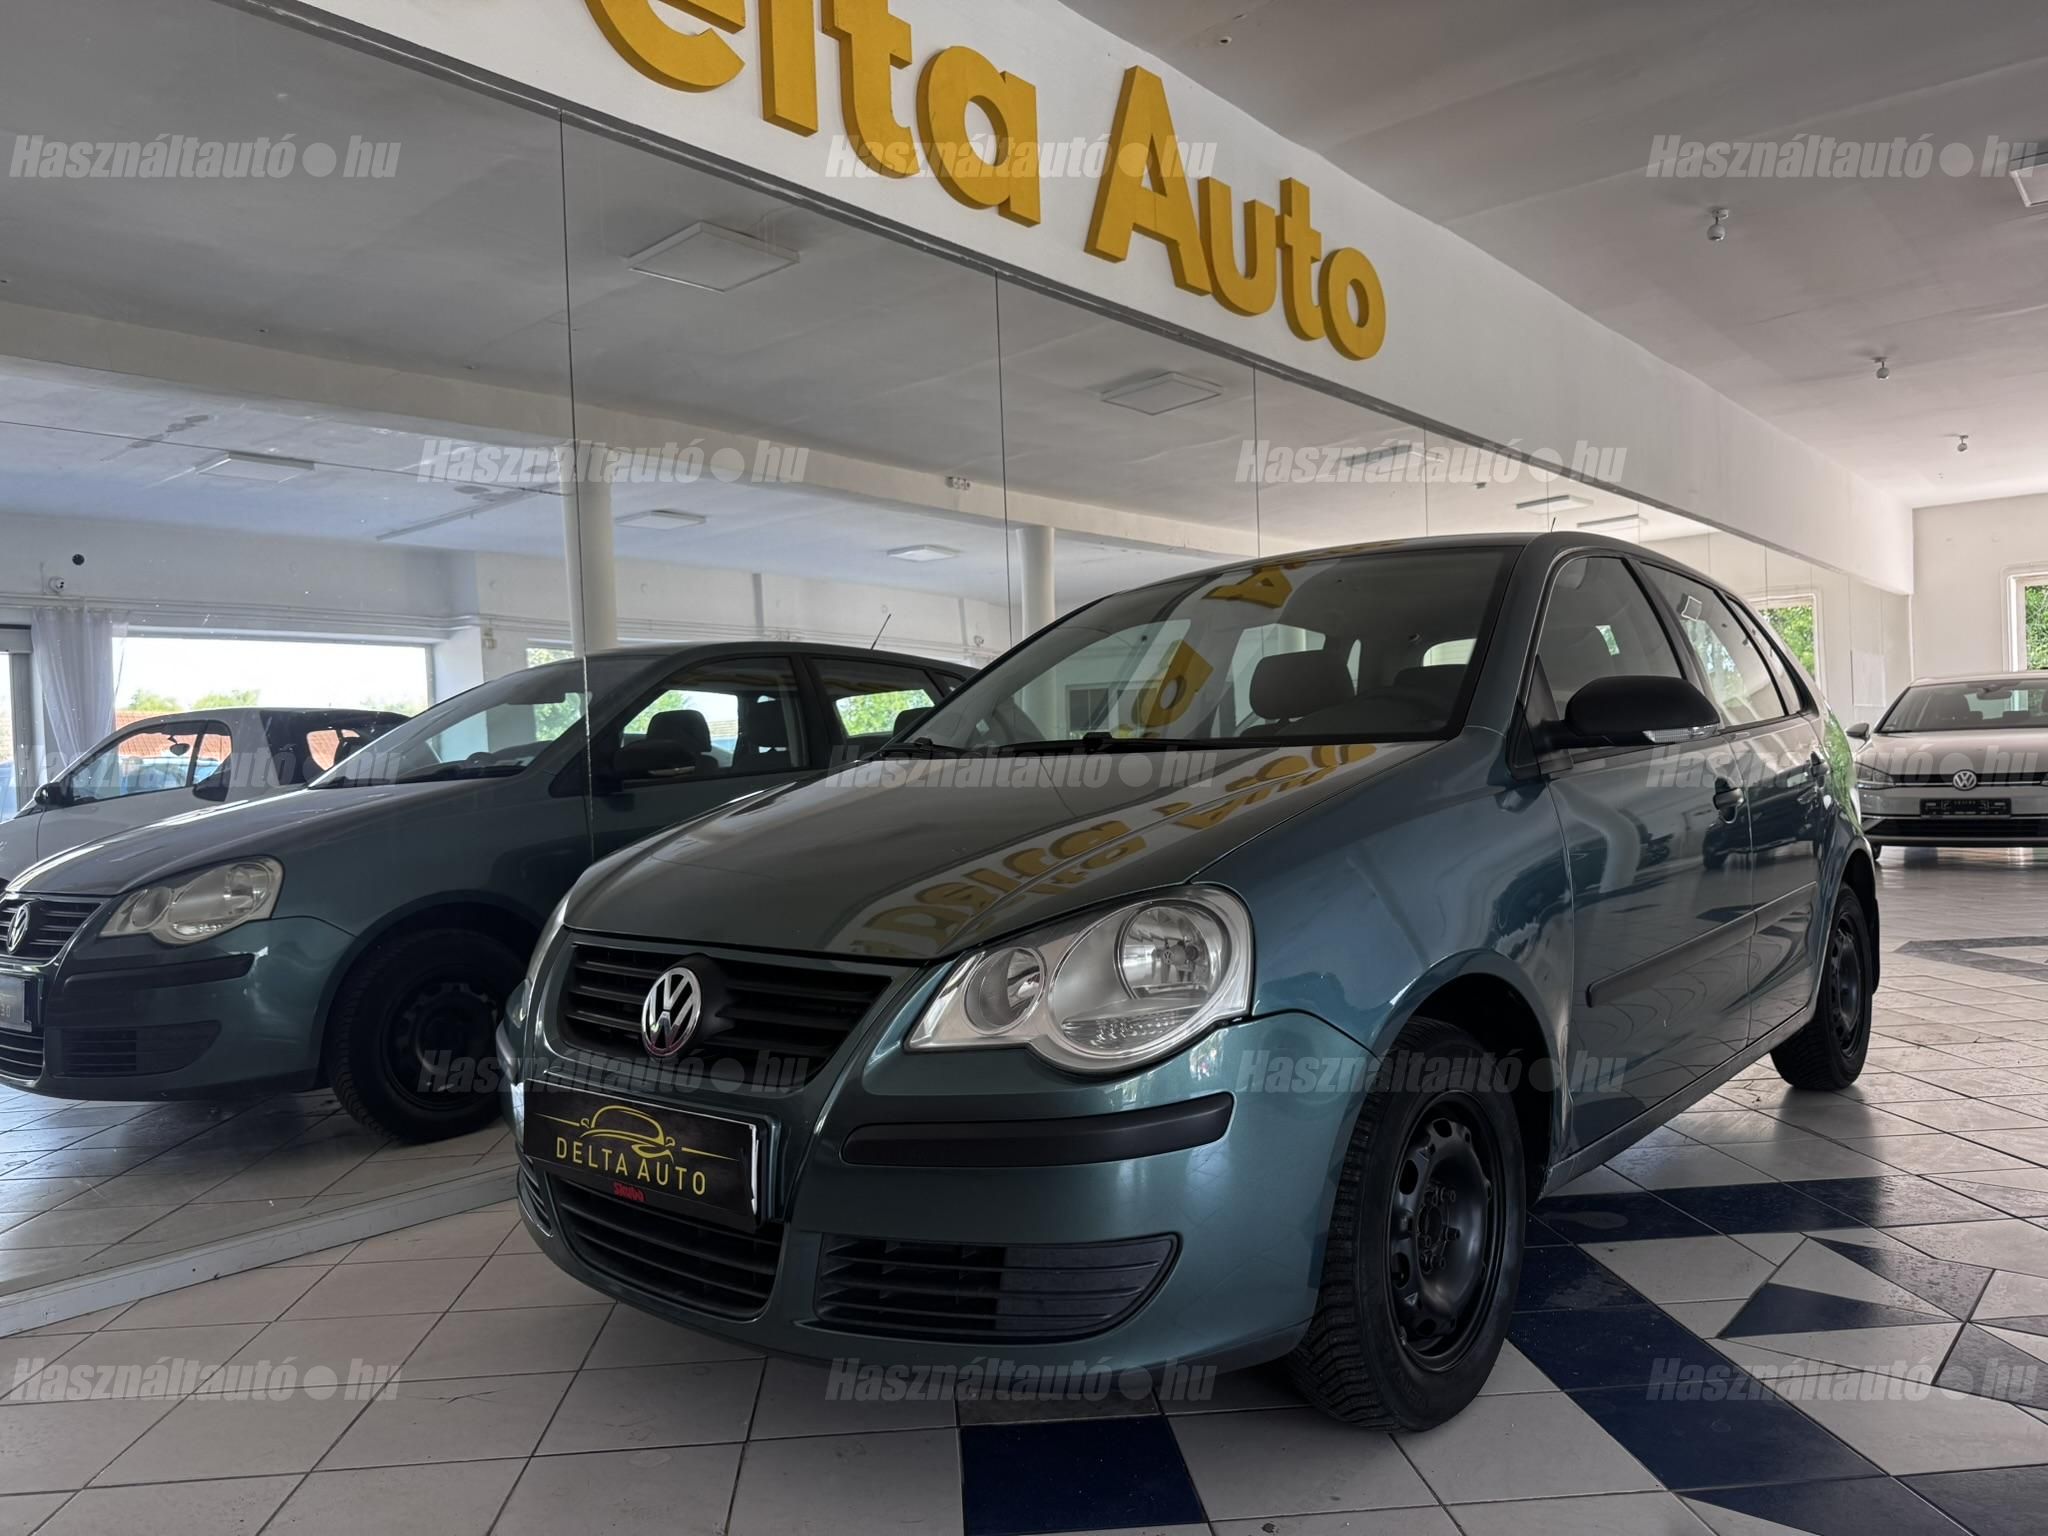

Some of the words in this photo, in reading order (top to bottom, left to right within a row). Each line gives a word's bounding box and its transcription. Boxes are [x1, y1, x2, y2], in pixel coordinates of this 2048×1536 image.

[1085, 66, 1386, 360] Auto
[556, 1135, 629, 1177] DELTA
[637, 1157, 707, 1196] AUTO
